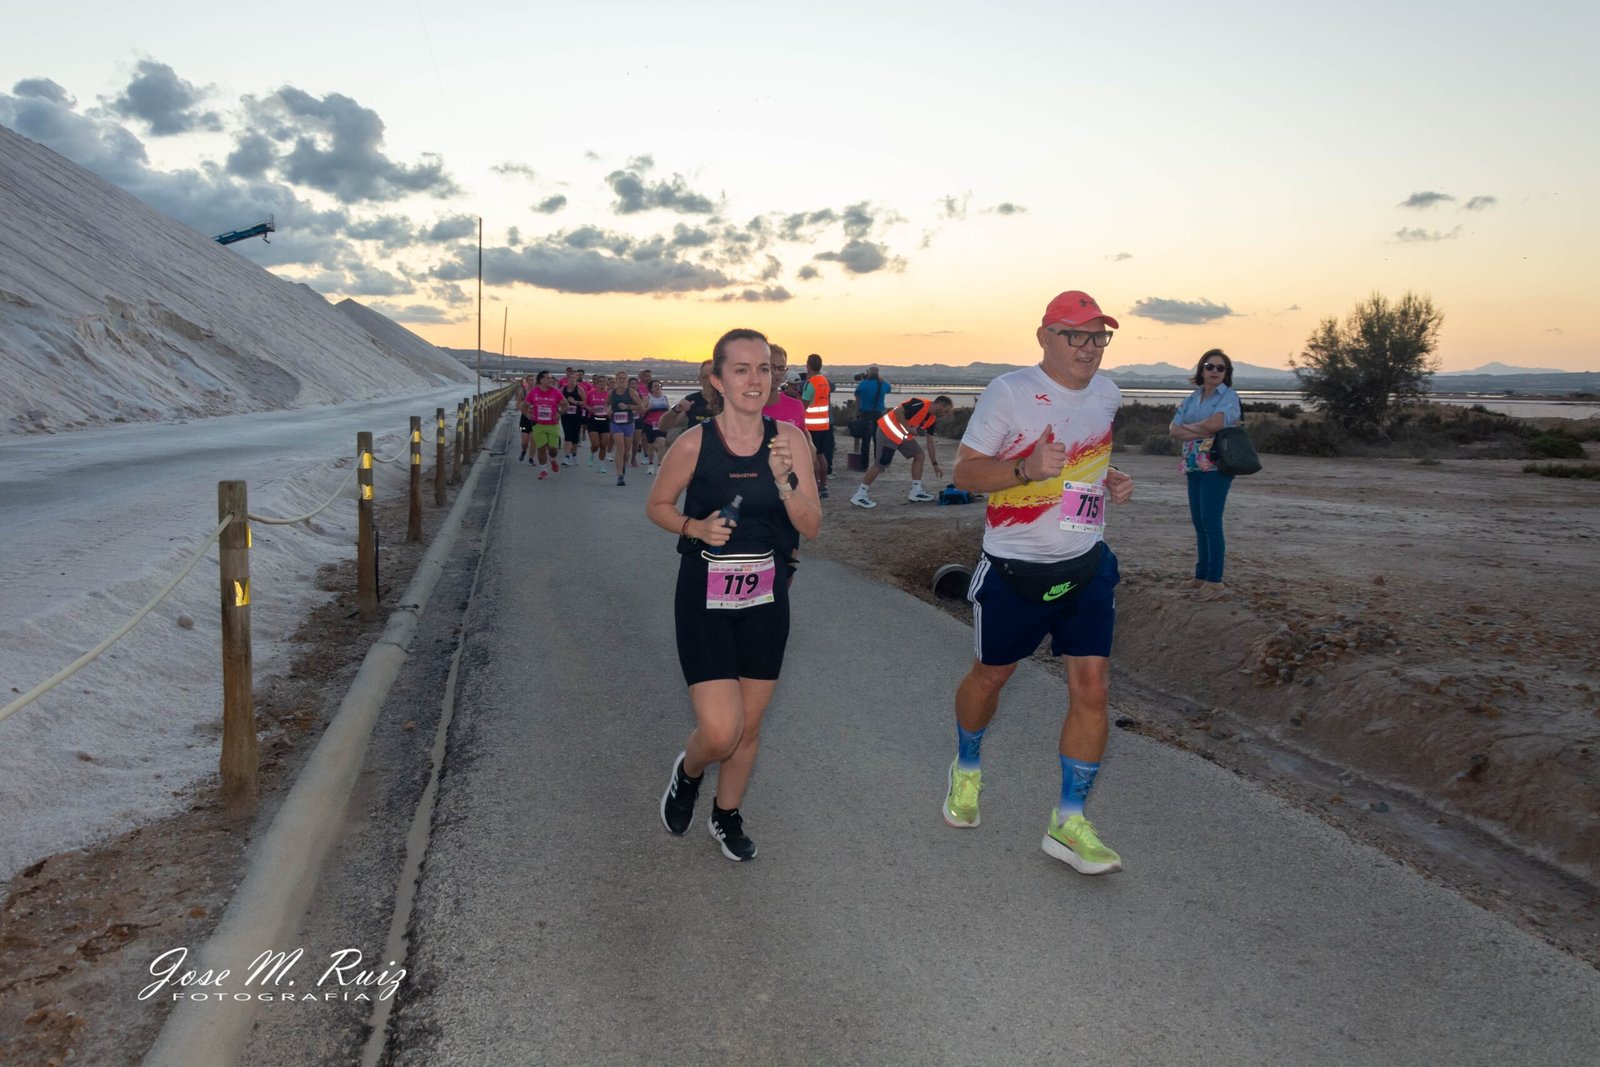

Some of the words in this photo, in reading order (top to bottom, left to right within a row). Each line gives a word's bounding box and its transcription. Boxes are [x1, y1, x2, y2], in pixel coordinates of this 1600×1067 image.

[1076, 494, 1100, 519] 715
[724, 573, 759, 595] 119
[1049, 581, 1071, 595] NIKE
